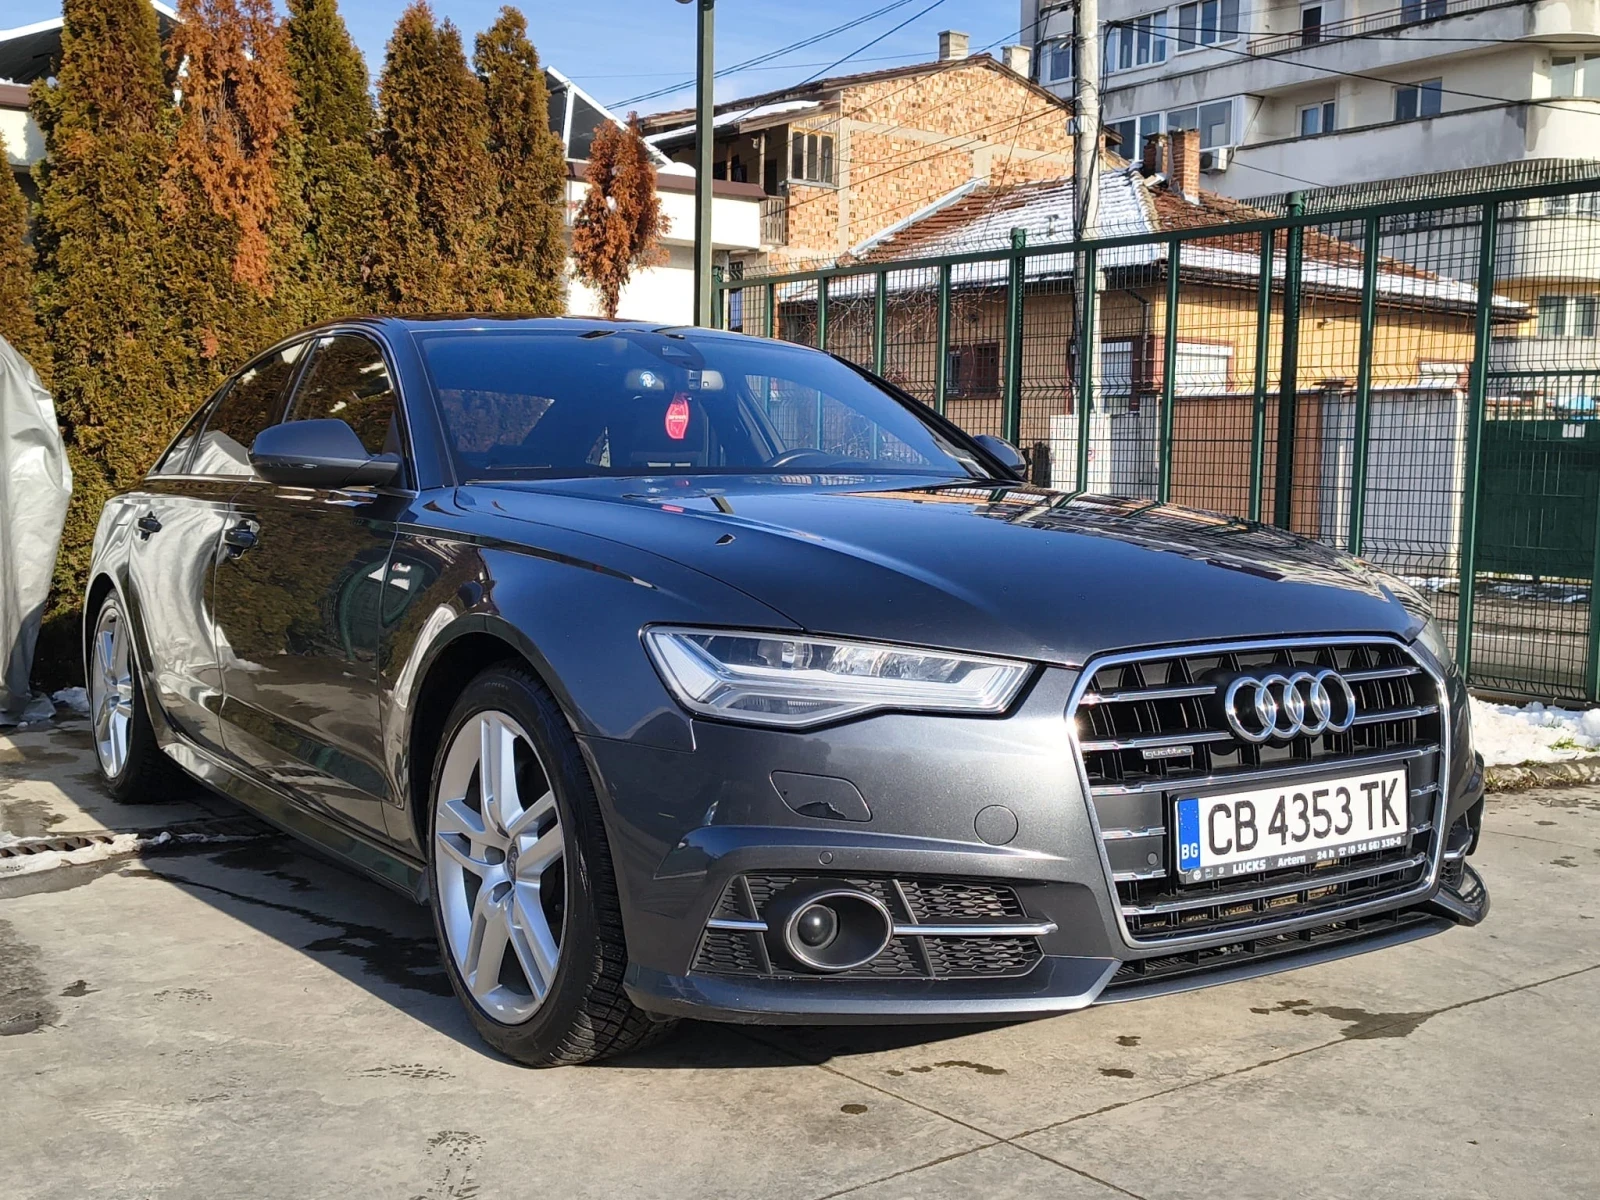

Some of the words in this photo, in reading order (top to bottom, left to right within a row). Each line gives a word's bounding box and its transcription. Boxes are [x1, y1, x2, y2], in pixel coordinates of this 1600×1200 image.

[1181, 843, 1199, 860] BG
[1208, 799, 1258, 856] CB
[1268, 786, 1353, 846] 4353
[1360, 777, 1400, 831] TK
[1232, 859, 1266, 875] LUCKS
[1277, 854, 1306, 867] Artern
[1317, 850, 1327, 860] 24
[1328, 848, 1335, 858] h
